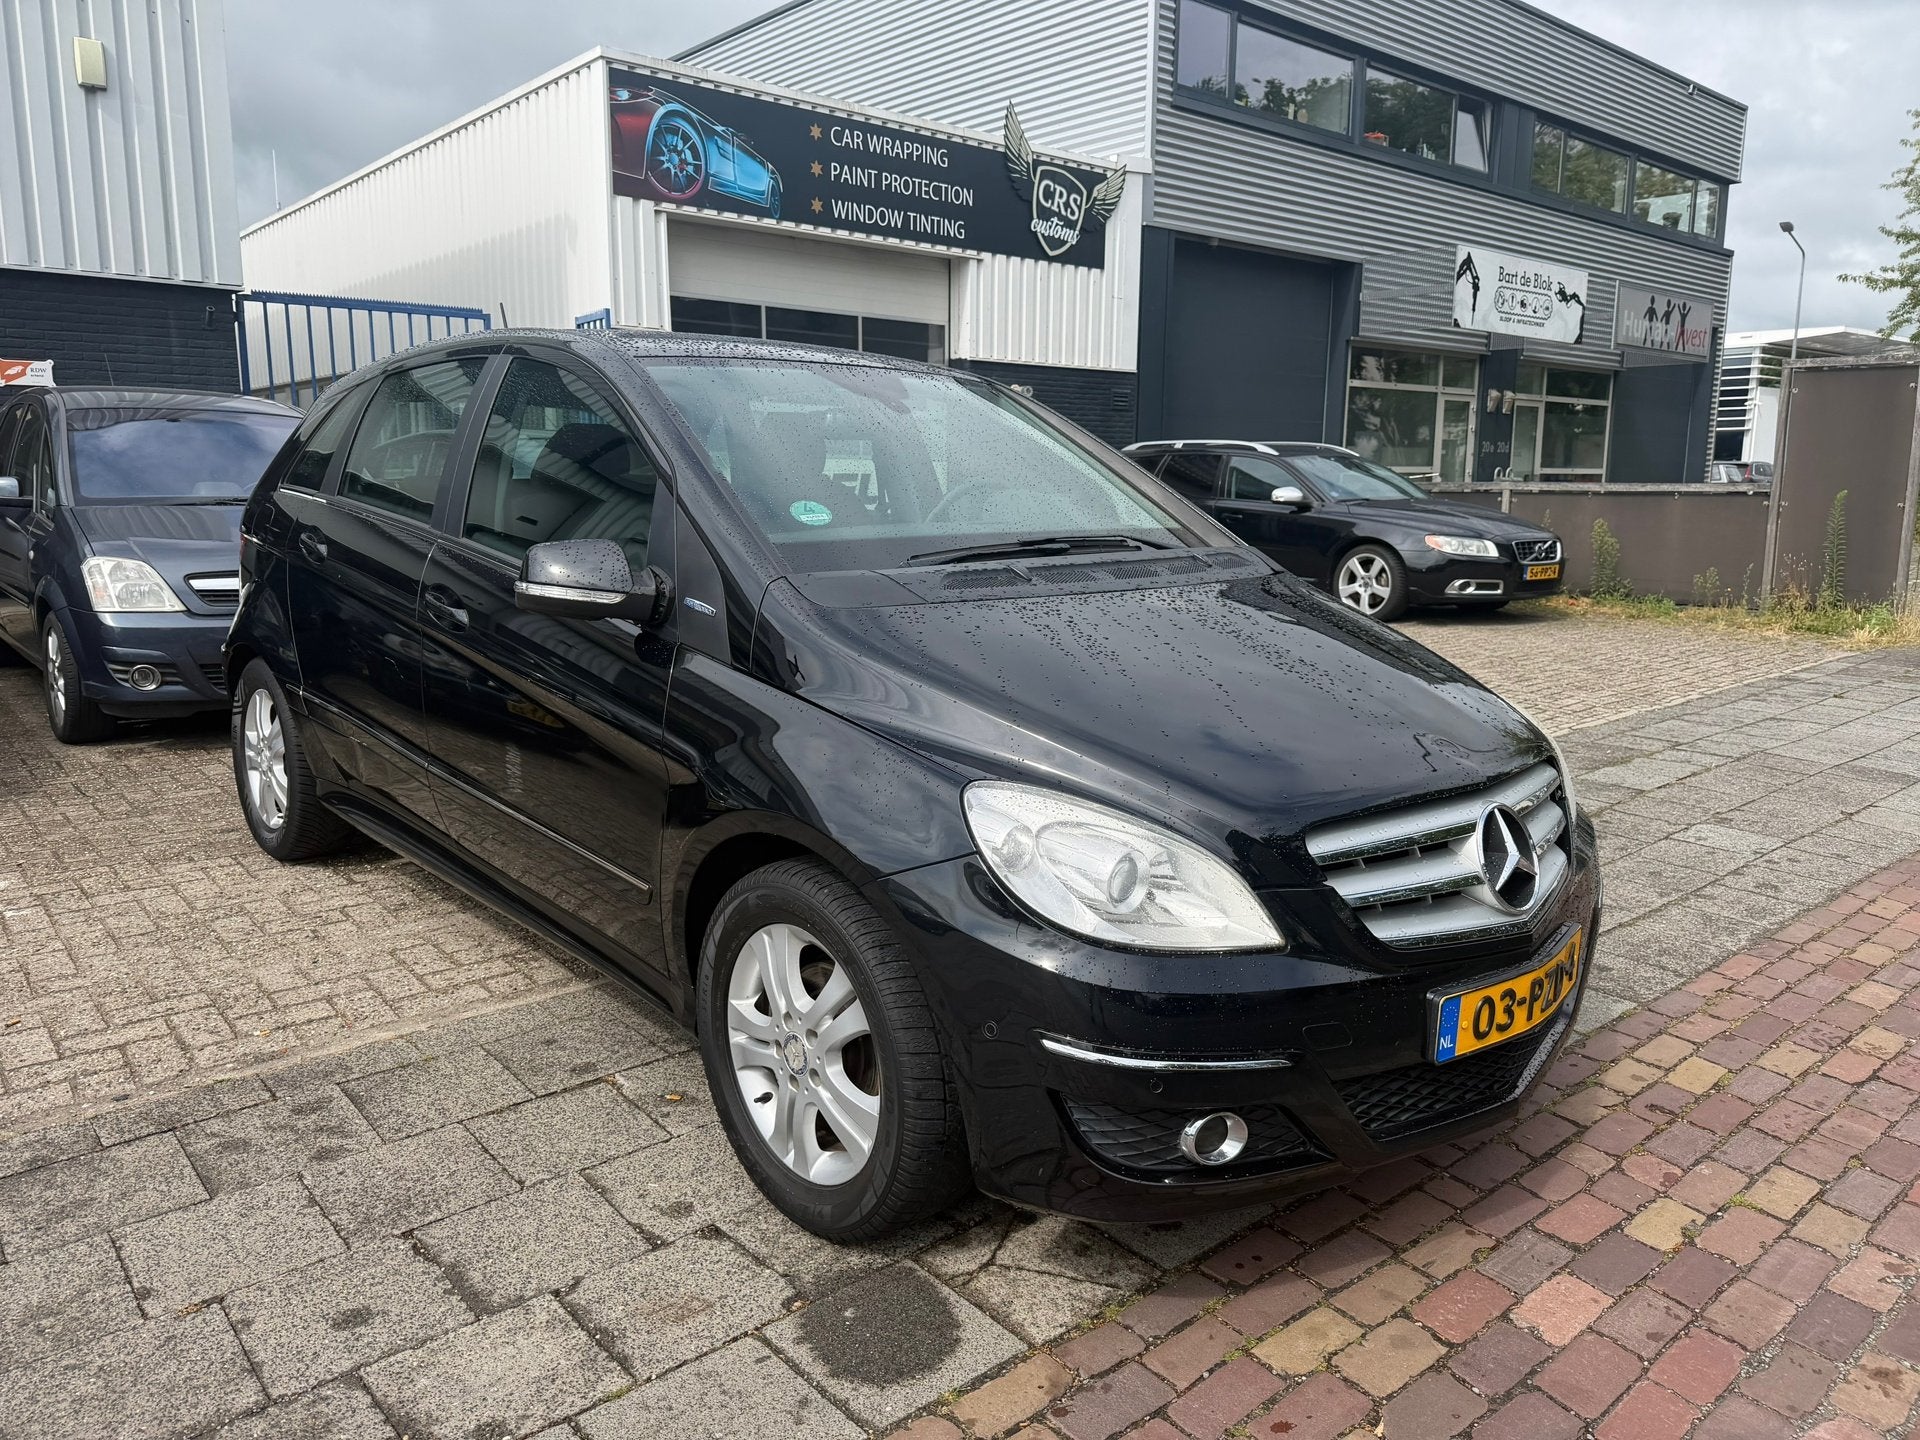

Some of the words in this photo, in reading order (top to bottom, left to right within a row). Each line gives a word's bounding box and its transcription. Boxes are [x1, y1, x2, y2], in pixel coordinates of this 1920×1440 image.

[830, 126, 863, 150] CAR
[867, 133, 948, 167] WRAPPING
[830, 162, 878, 189] PAINT
[882, 172, 973, 206] PROTECTION
[1038, 179, 1081, 220] CRS
[831, 198, 904, 228] WINDOW
[907, 211, 965, 239] TINTING
[1031, 217, 1081, 245] customs
[1498, 265, 1518, 285] Bart
[1520, 271, 1531, 287] de
[1533, 273, 1552, 291] Blok
[1439, 1034, 1454, 1050] NL
